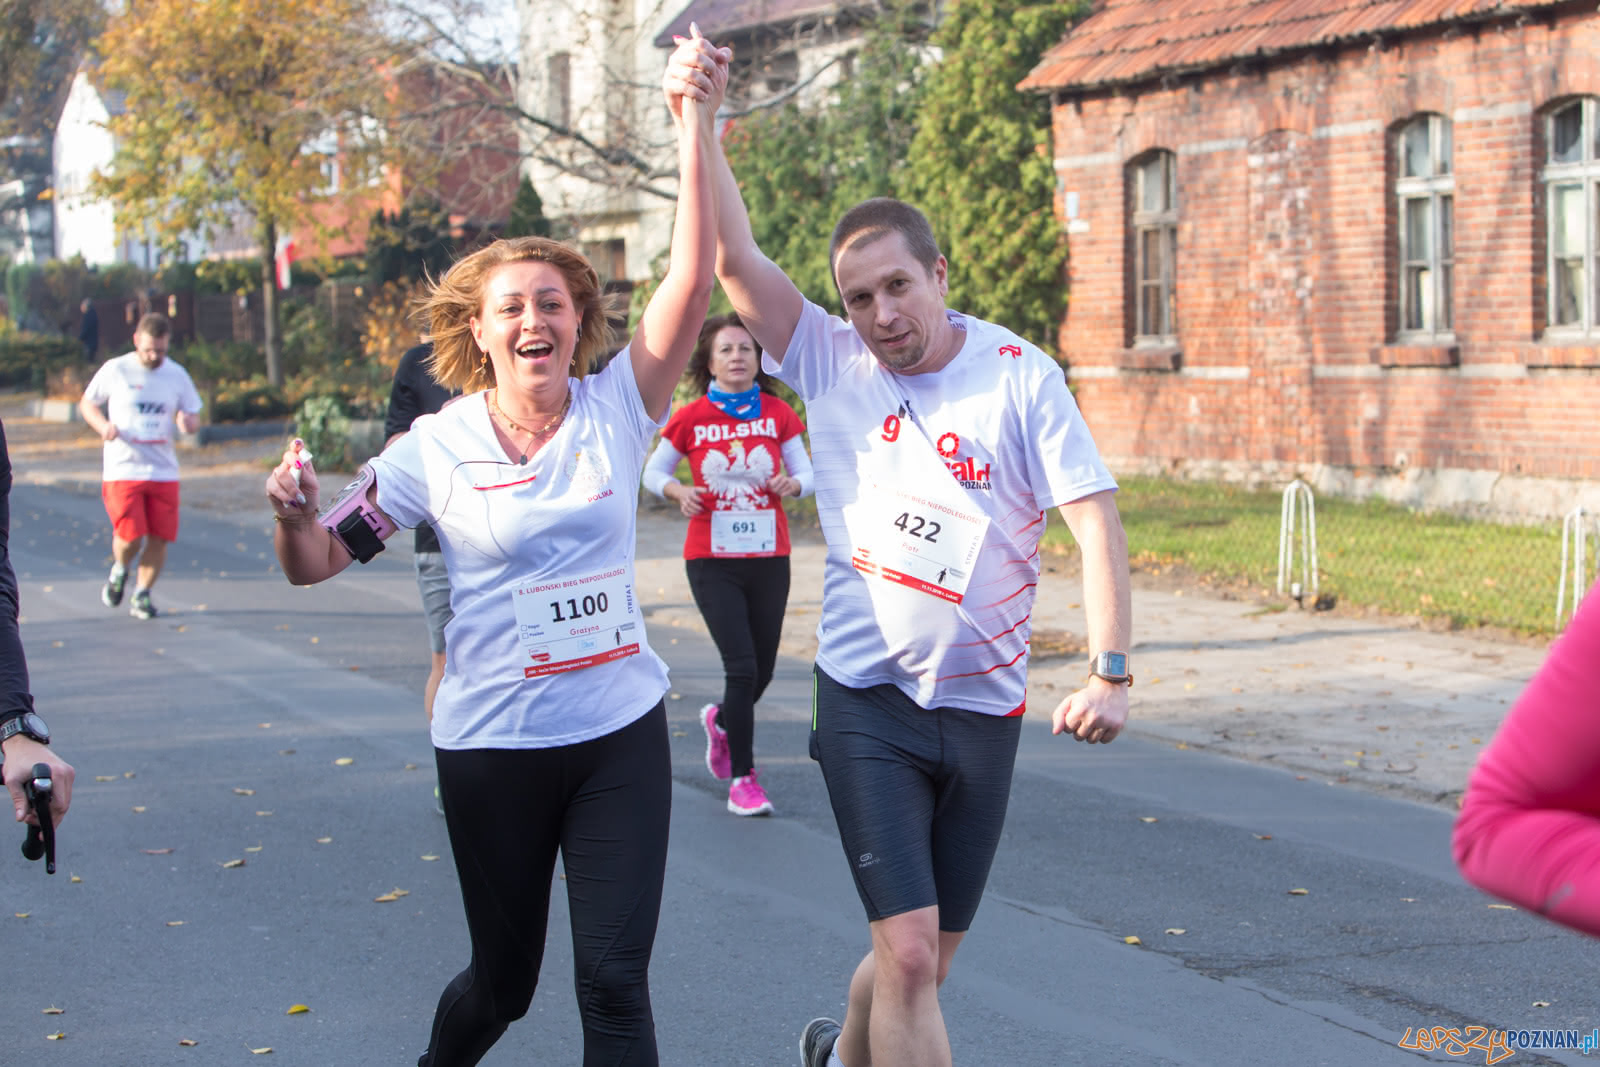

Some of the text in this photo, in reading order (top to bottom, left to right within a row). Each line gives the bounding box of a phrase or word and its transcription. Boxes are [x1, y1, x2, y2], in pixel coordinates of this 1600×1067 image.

[694, 417, 778, 447] POLSKA
[732, 521, 756, 533] 691
[894, 512, 942, 544] 422
[902, 542, 920, 553] Piotr
[526, 583, 562, 594] LUBOŃSKI
[563, 579, 578, 588] BIEG
[579, 568, 625, 585] NIEPODLEGŁOŚCI
[550, 592, 608, 623] 1100
[626, 589, 634, 614] STREFA
[569, 625, 600, 636] Grażyna
